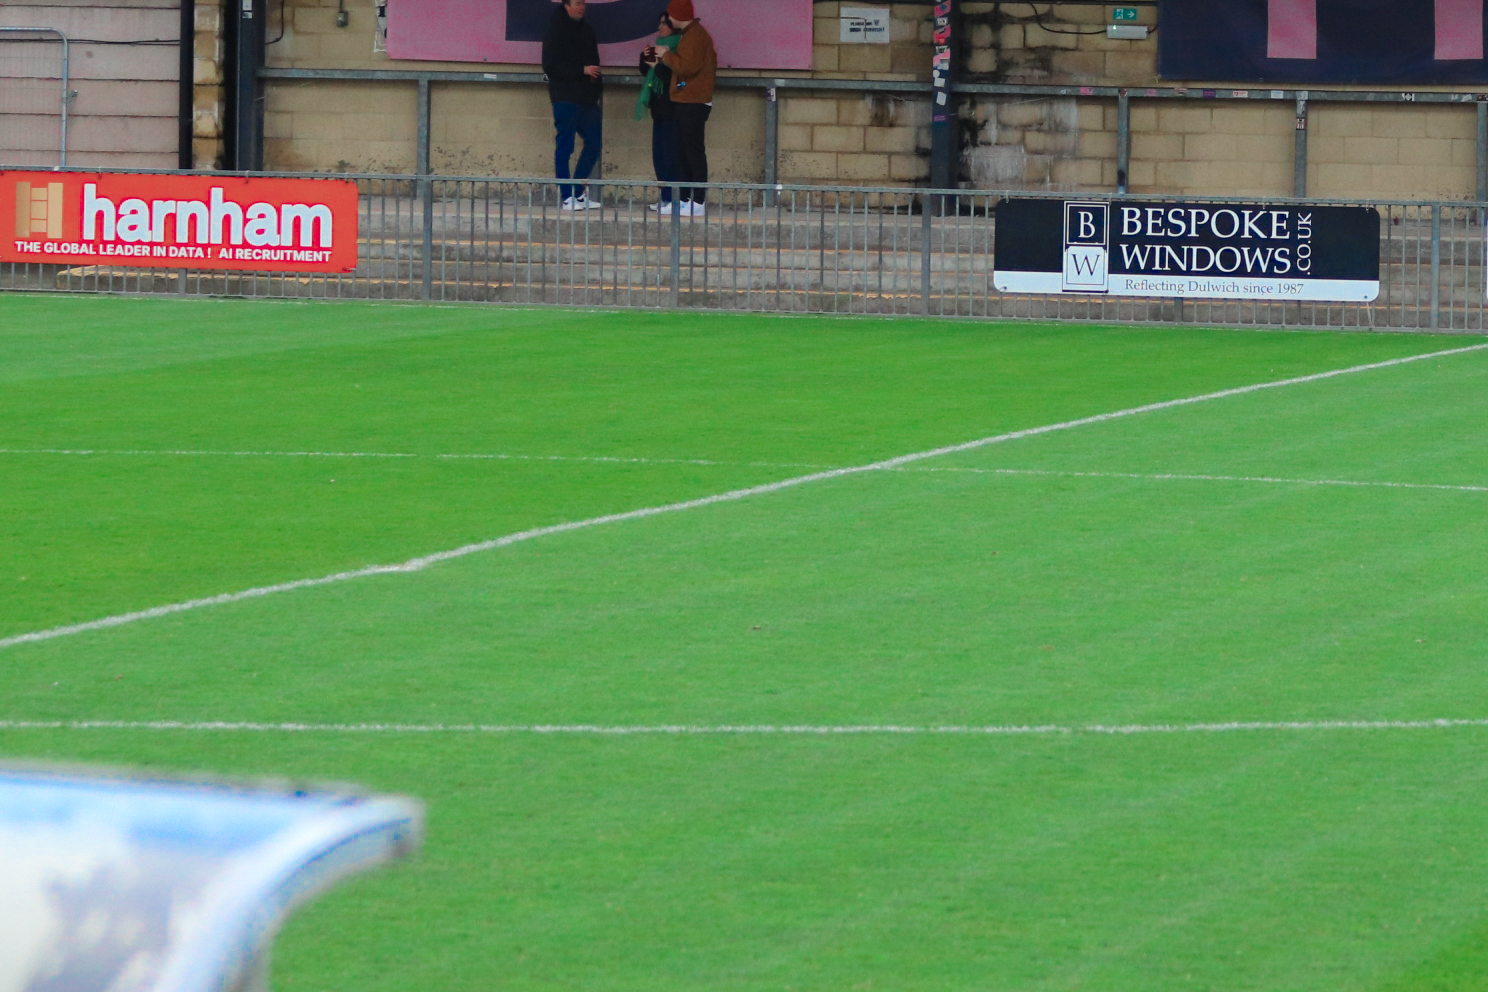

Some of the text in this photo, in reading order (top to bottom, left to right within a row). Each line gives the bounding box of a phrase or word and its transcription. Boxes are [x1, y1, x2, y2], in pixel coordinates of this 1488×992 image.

[82, 183, 333, 247] harnham
[1078, 211, 1096, 238] B
[1120, 207, 1291, 239] BESPOKE
[15, 241, 41, 253] THE
[44, 243, 97, 255] GLOBAL
[99, 244, 150, 257] LEADER
[153, 246, 167, 257] IN
[169, 246, 204, 258] DATA
[236, 249, 332, 262] RECRUITMENT
[1296, 212, 1312, 276] .CO.UK
[1072, 254, 1100, 276] W
[1119, 244, 1292, 274] WINDOWS
[1125, 279, 1304, 295] Reflecting Dulwich since 1987
